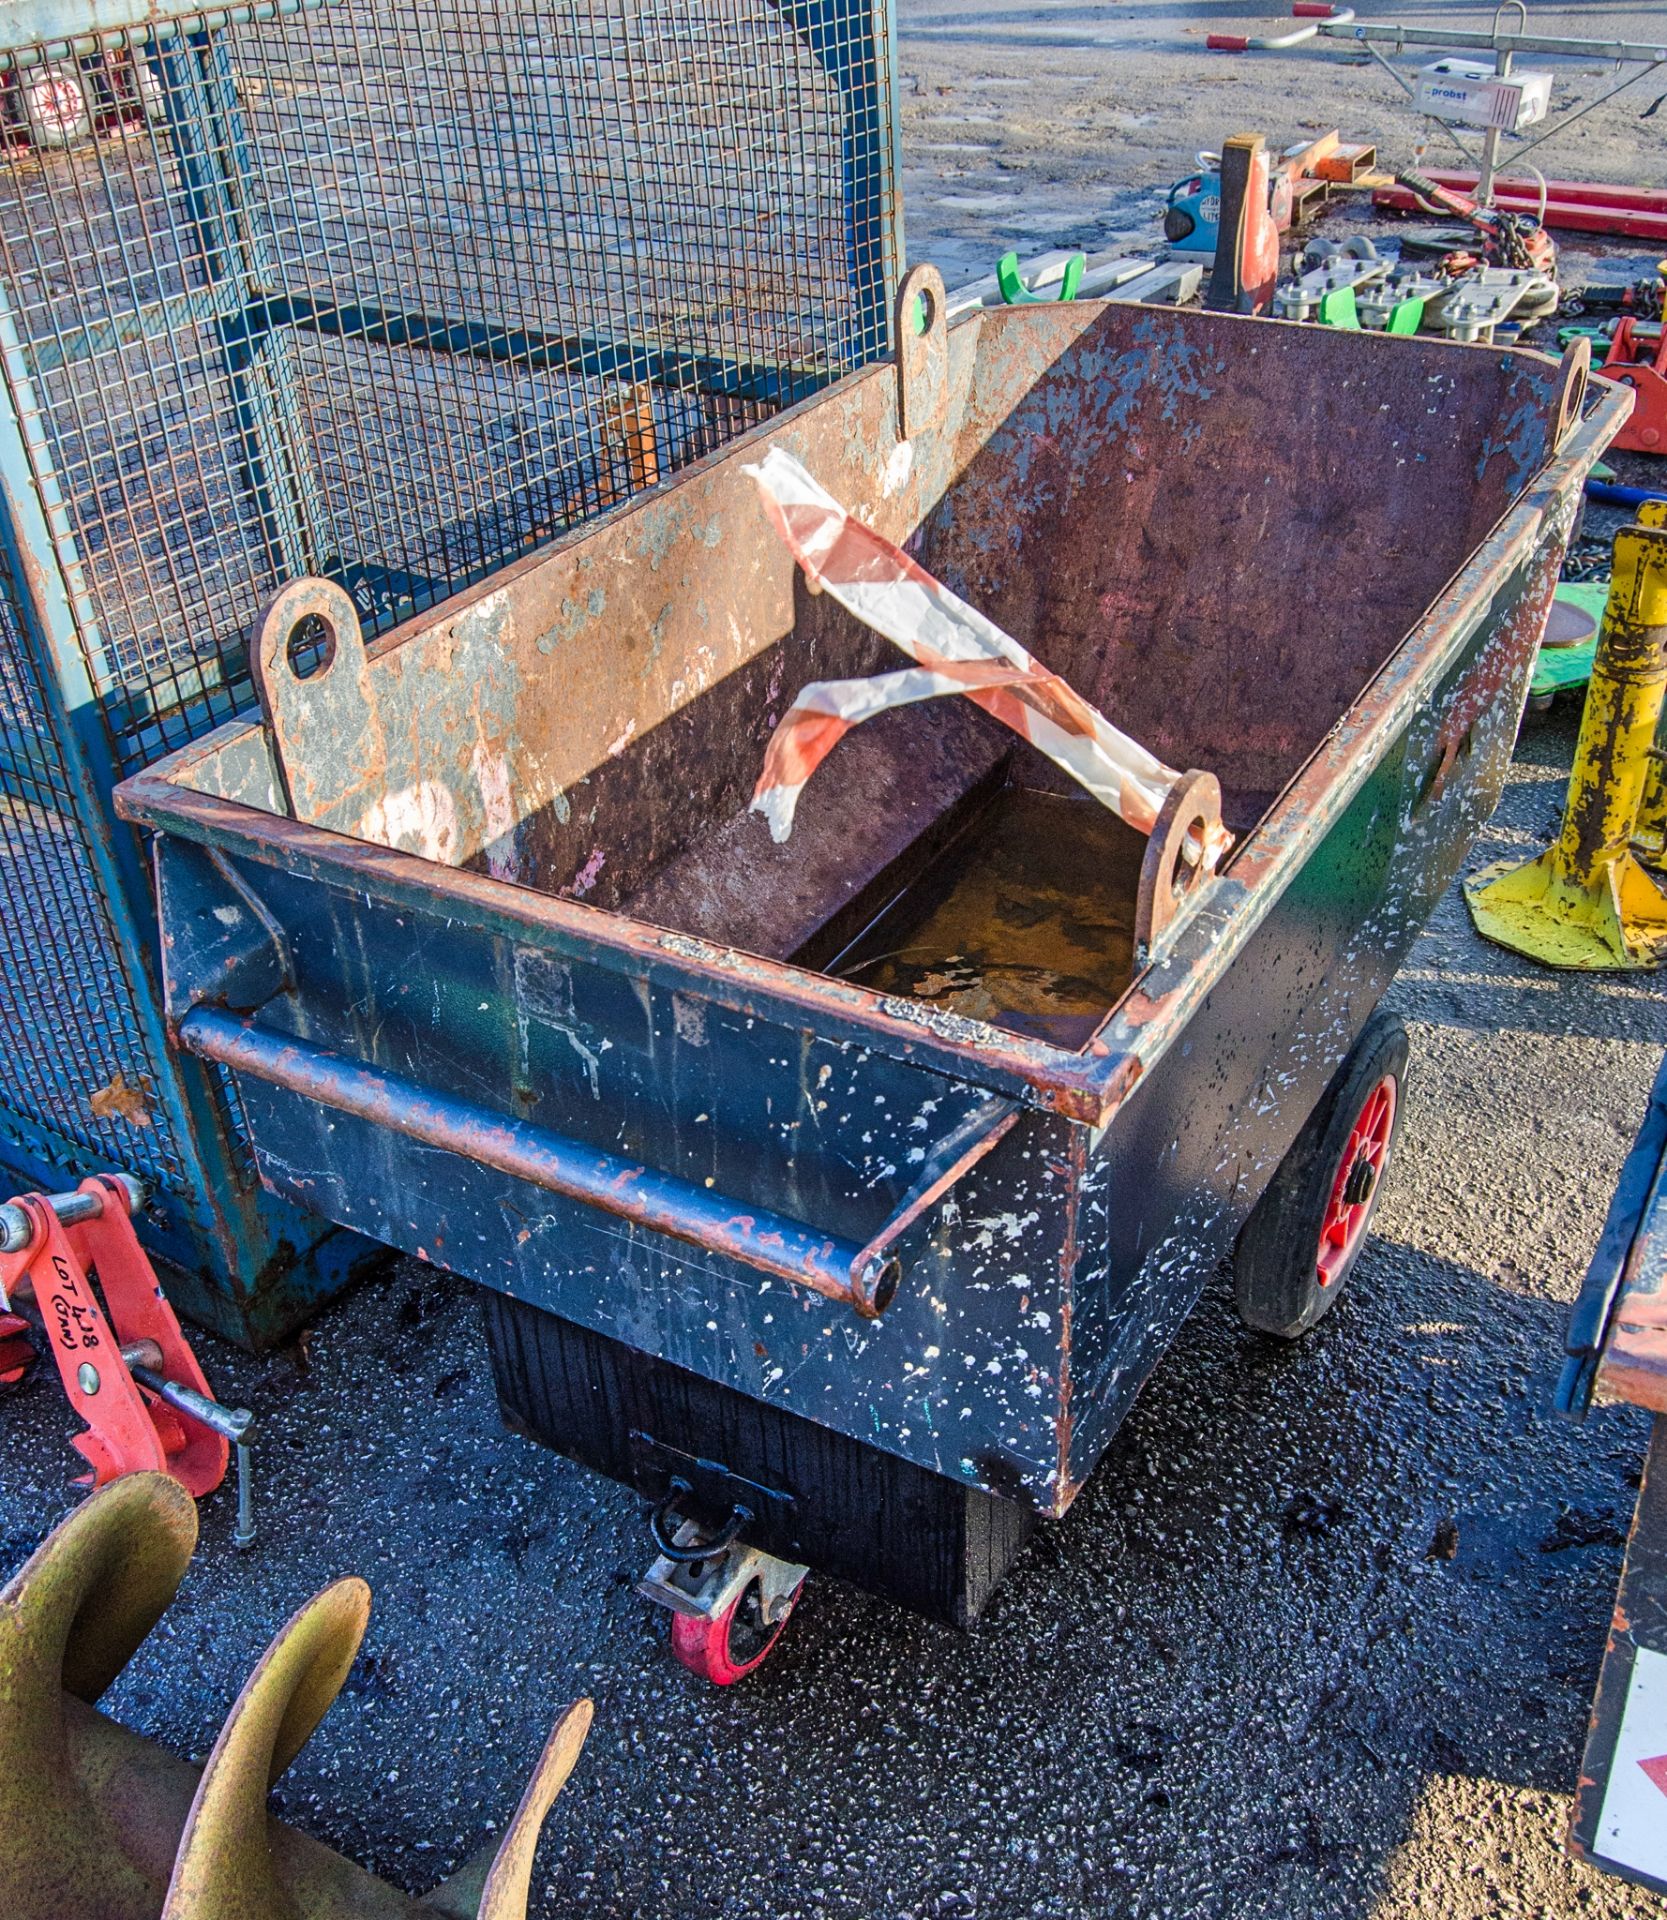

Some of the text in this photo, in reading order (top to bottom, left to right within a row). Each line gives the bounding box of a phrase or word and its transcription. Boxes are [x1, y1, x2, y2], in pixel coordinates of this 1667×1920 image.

[1431, 87, 1467, 100] probst
[52, 1256, 99, 1348] LOT 418
